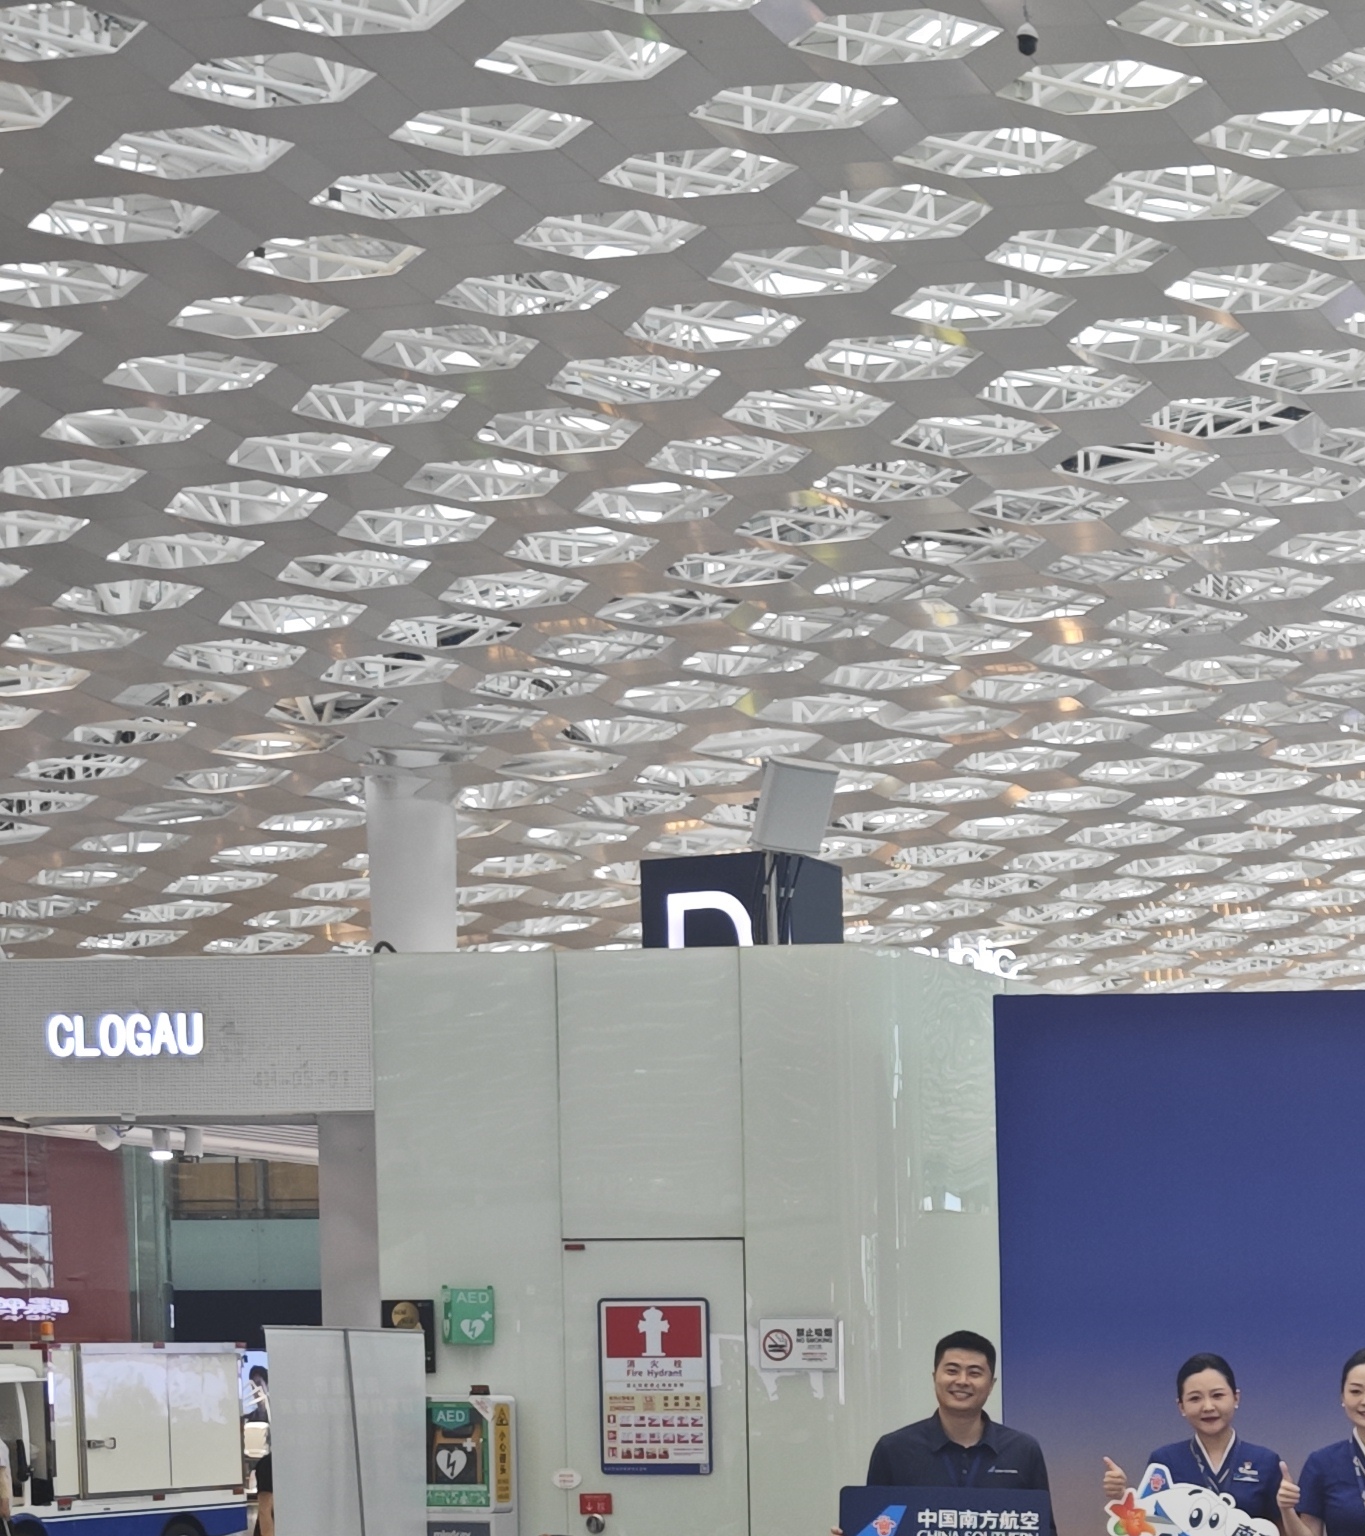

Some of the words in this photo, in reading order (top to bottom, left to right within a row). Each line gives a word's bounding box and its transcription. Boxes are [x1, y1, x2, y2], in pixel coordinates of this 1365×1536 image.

[48, 1012, 204, 1057] CLOGAU
[456, 1291, 490, 1304] AED
[626, 1369, 643, 1378] Fire
[647, 1369, 683, 1379] Hydrant
[436, 1410, 466, 1422] AED
[917, 1508, 1040, 1530] 中国南方航空
